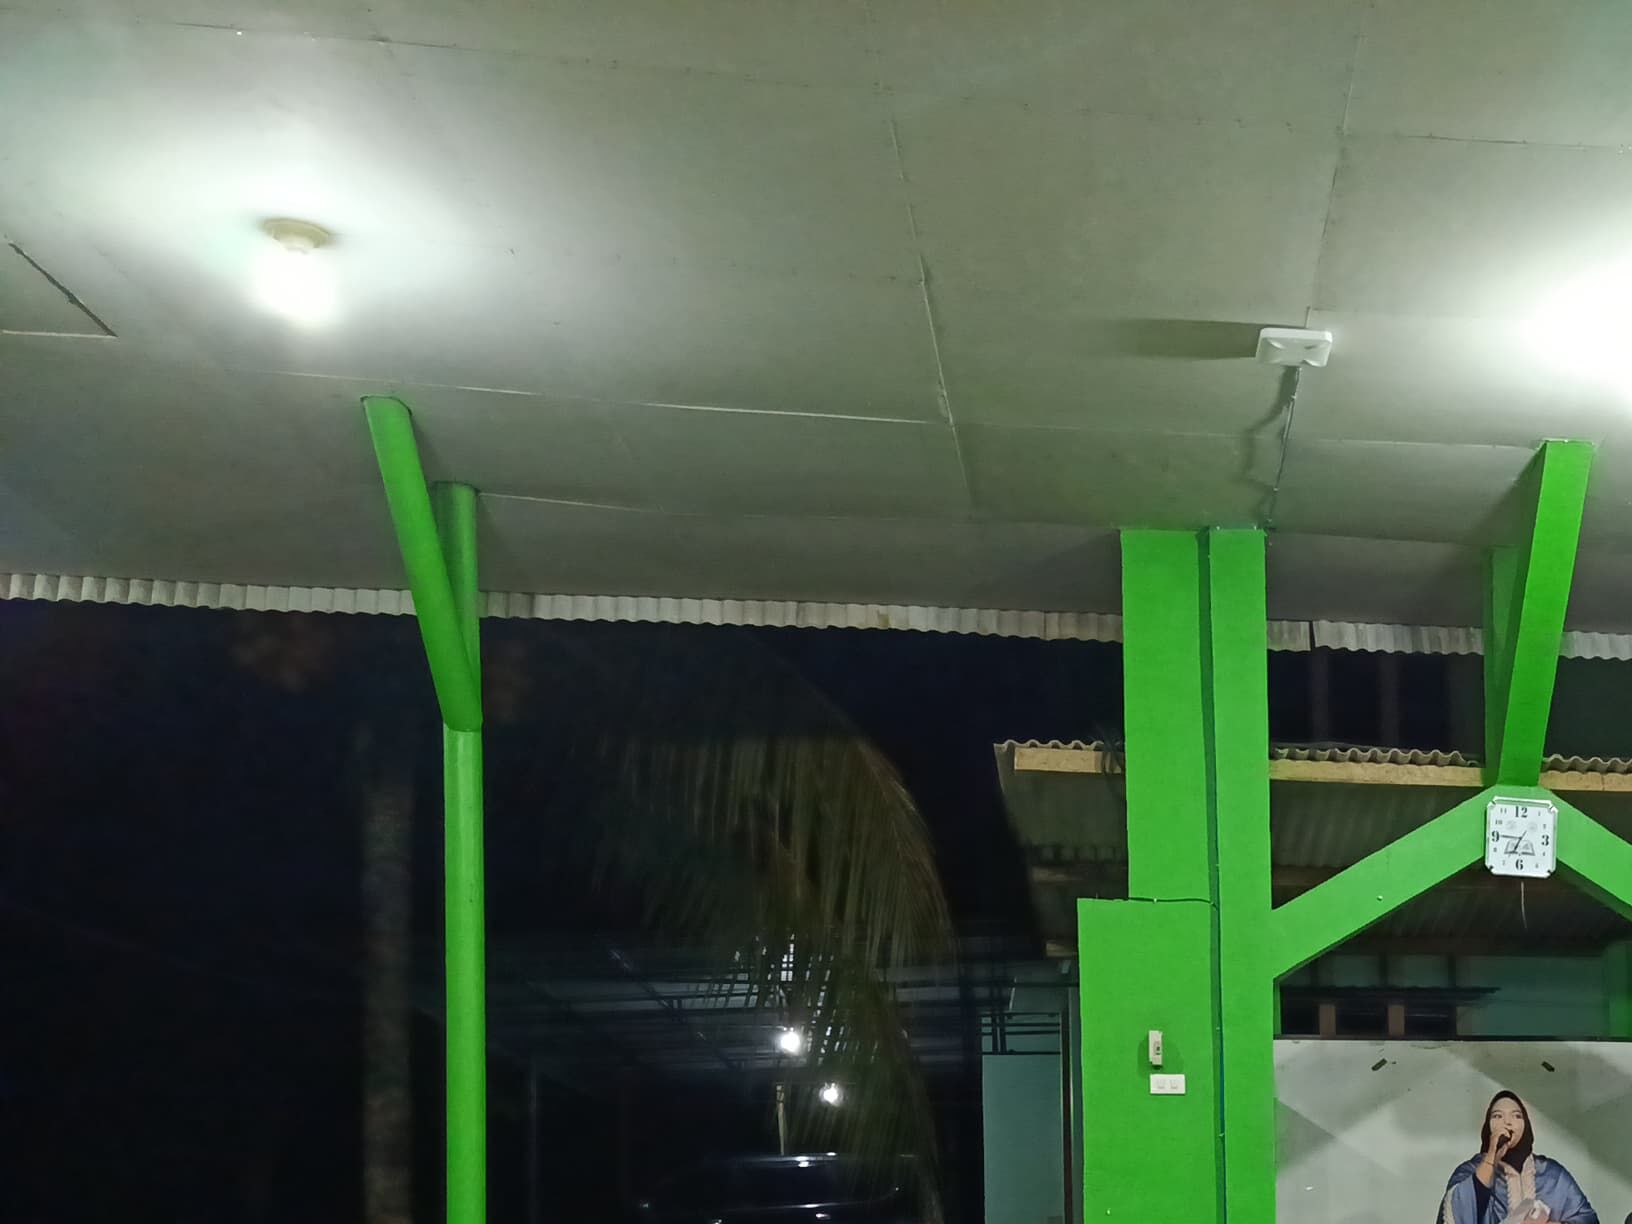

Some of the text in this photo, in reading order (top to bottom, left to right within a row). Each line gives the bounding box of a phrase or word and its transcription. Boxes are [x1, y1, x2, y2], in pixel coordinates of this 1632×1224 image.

[1515, 806, 1528, 818] 12
[1491, 830, 1500, 842] 9
[1541, 834, 1549, 846] 3
[1515, 859, 1524, 870] 6
